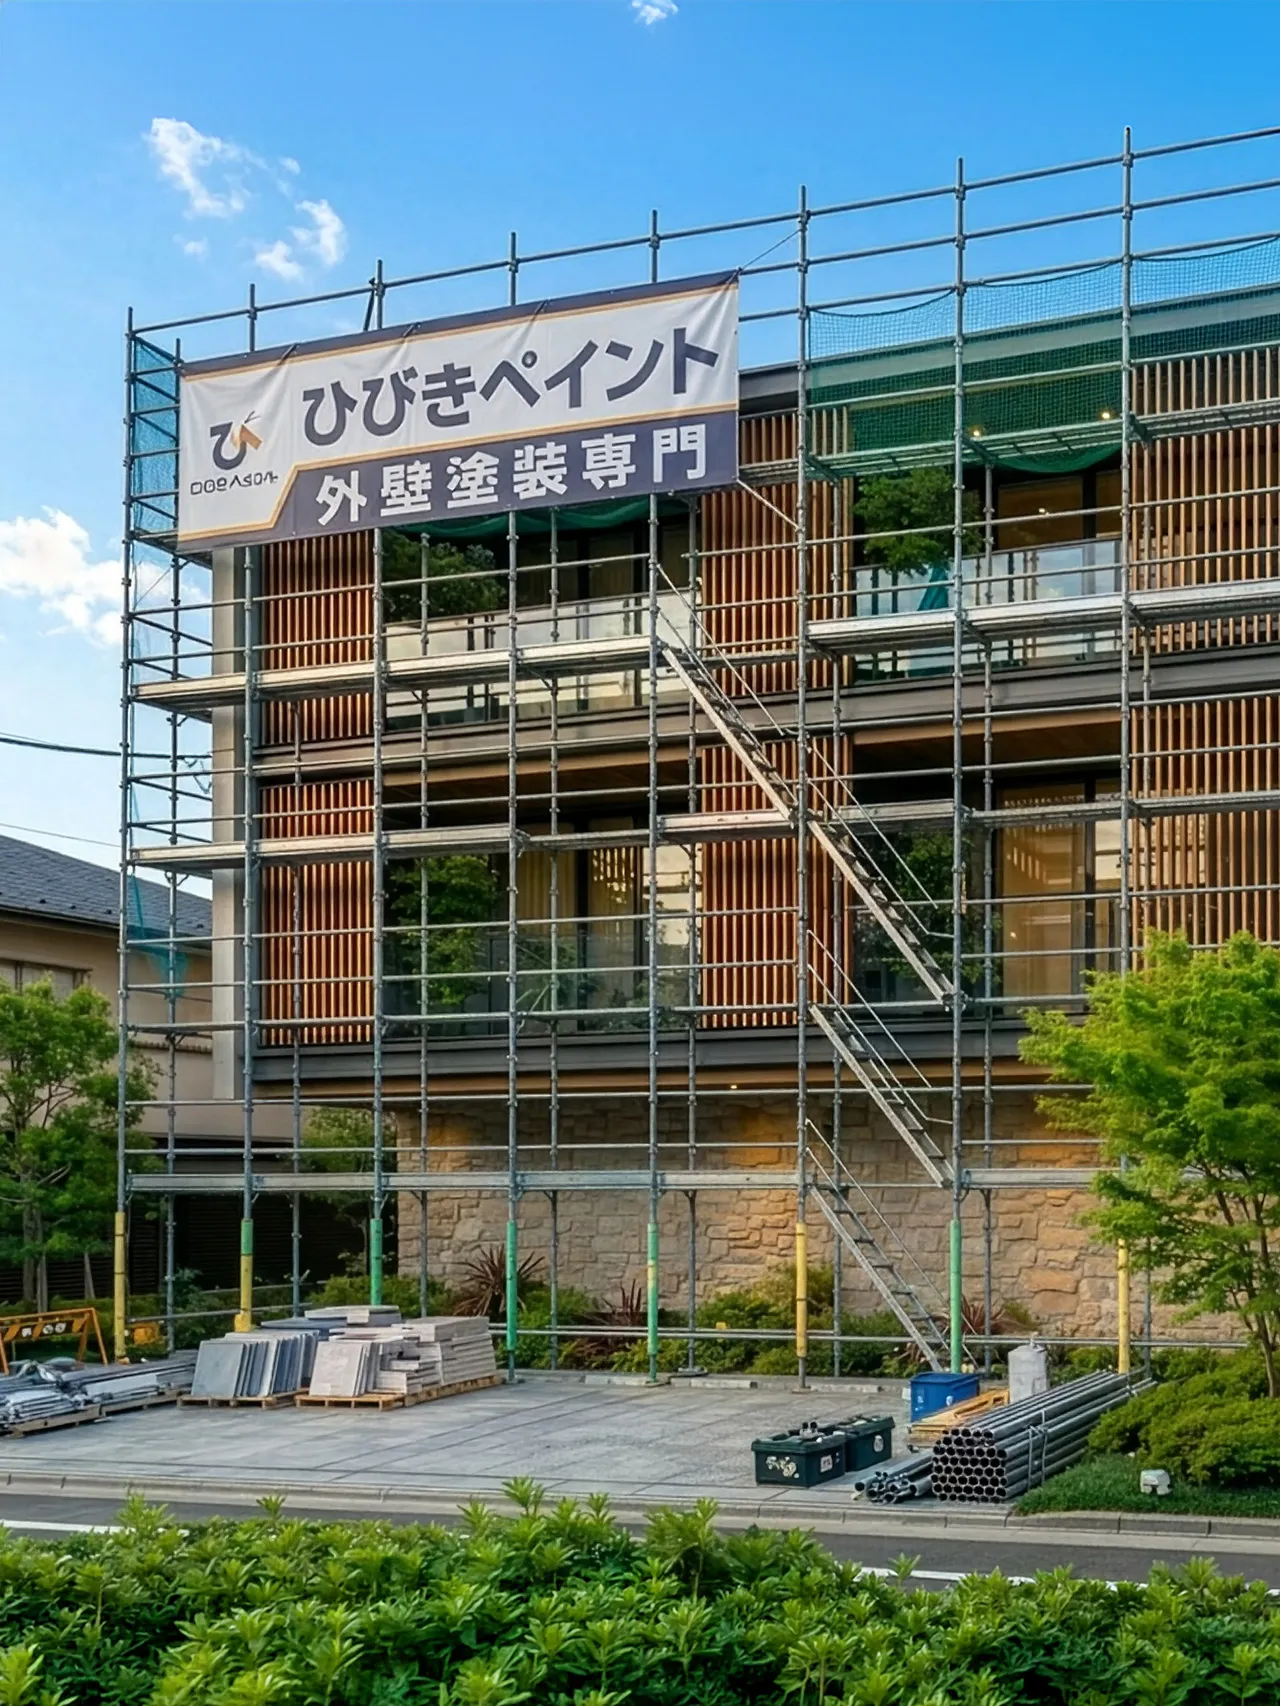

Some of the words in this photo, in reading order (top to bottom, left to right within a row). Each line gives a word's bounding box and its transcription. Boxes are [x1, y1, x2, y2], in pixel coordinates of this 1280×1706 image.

[302, 327, 720, 446] ひびきペイント
[316, 423, 706, 527] 外壁塗装専門
